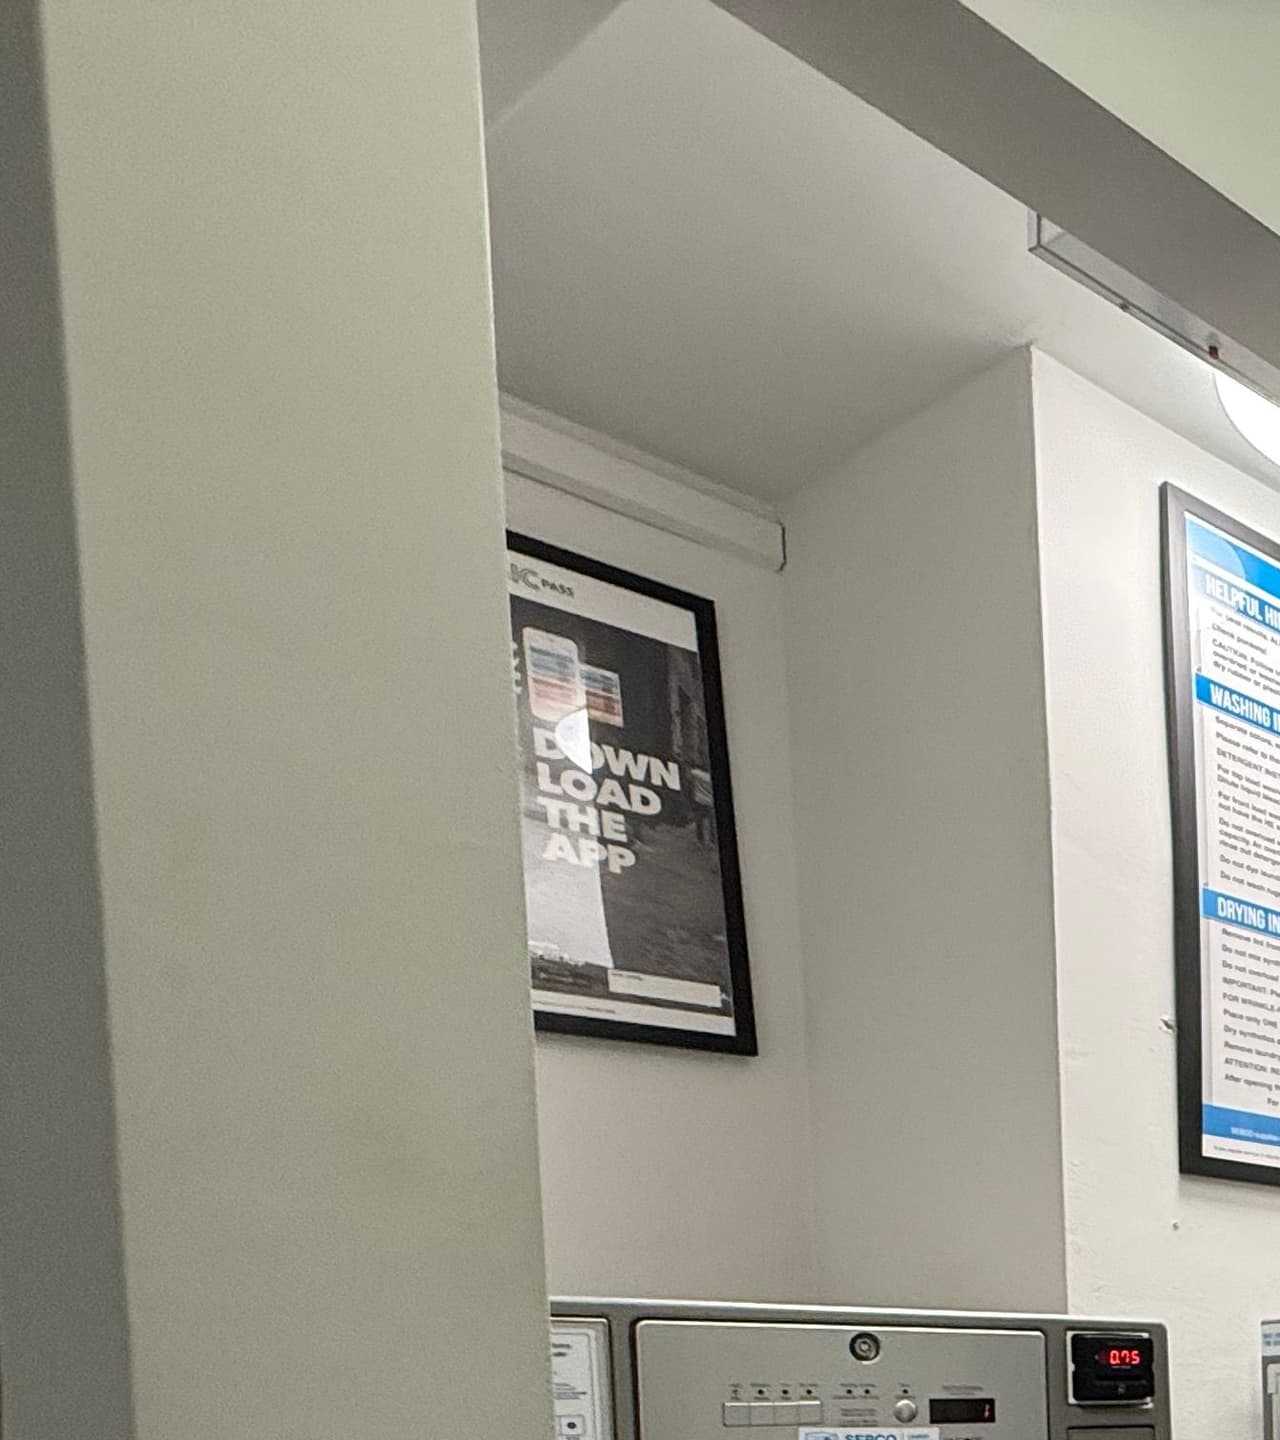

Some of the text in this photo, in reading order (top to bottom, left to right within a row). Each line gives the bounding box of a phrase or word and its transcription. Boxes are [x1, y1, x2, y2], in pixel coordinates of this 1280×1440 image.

[541, 579, 575, 597] PASS
[1205, 573, 1263, 622] HELPFUL
[1210, 683, 1270, 729] WASHING
[536, 762, 661, 815] LOAD
[537, 796, 627, 842] THE
[543, 832, 635, 874] APP
[1217, 896, 1265, 930] DRYING
[1109, 1350, 1140, 1365] 0.75
